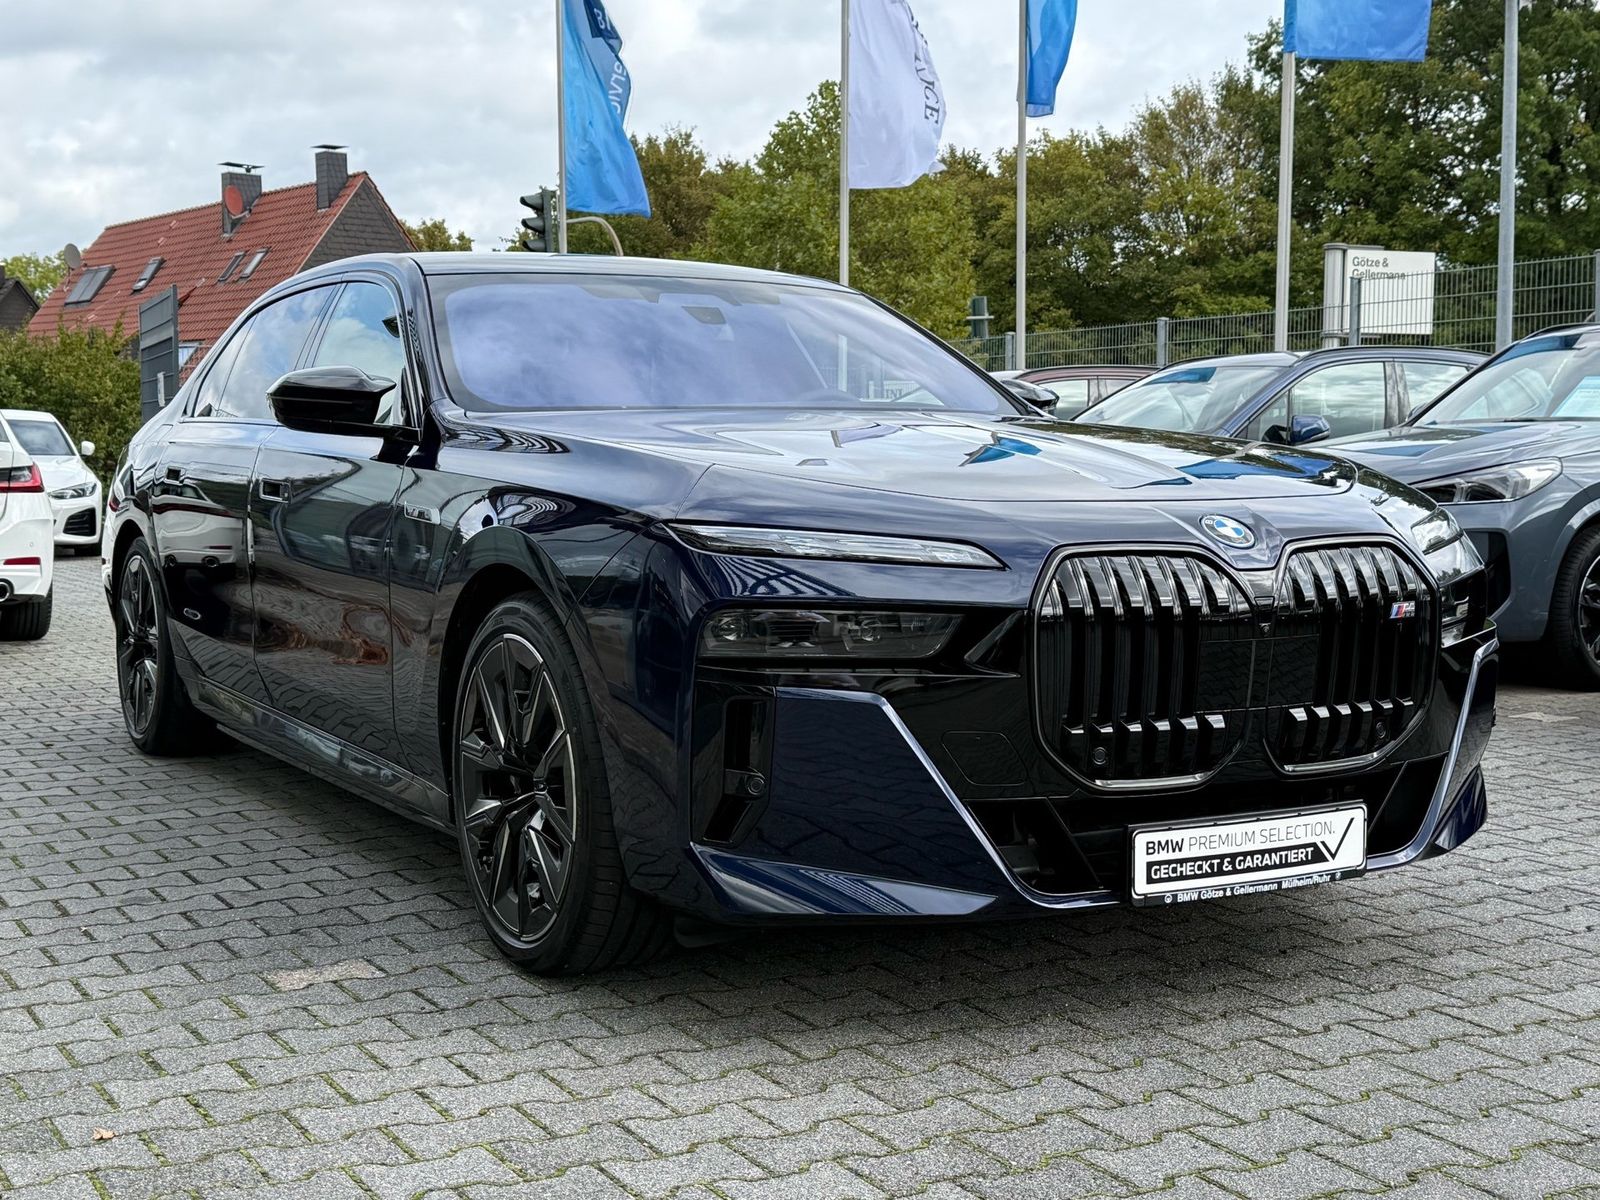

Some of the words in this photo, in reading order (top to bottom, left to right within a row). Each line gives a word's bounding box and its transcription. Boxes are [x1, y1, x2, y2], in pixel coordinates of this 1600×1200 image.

[1352, 256, 1381, 268] Götze
[1382, 257, 1389, 268] &
[1146, 837, 1185, 856] BMW
[1188, 830, 1256, 852] PREMIUM
[1259, 820, 1336, 844] SELECTION.
[1150, 858, 1221, 880] GECHECKT
[1222, 857, 1233, 871] &
[1235, 847, 1315, 870] GARANTIERT
[1177, 892, 1199, 903] BMW
[1200, 888, 1224, 899] Götze
[1225, 887, 1232, 896] &
[1233, 882, 1278, 895] Gellermann
